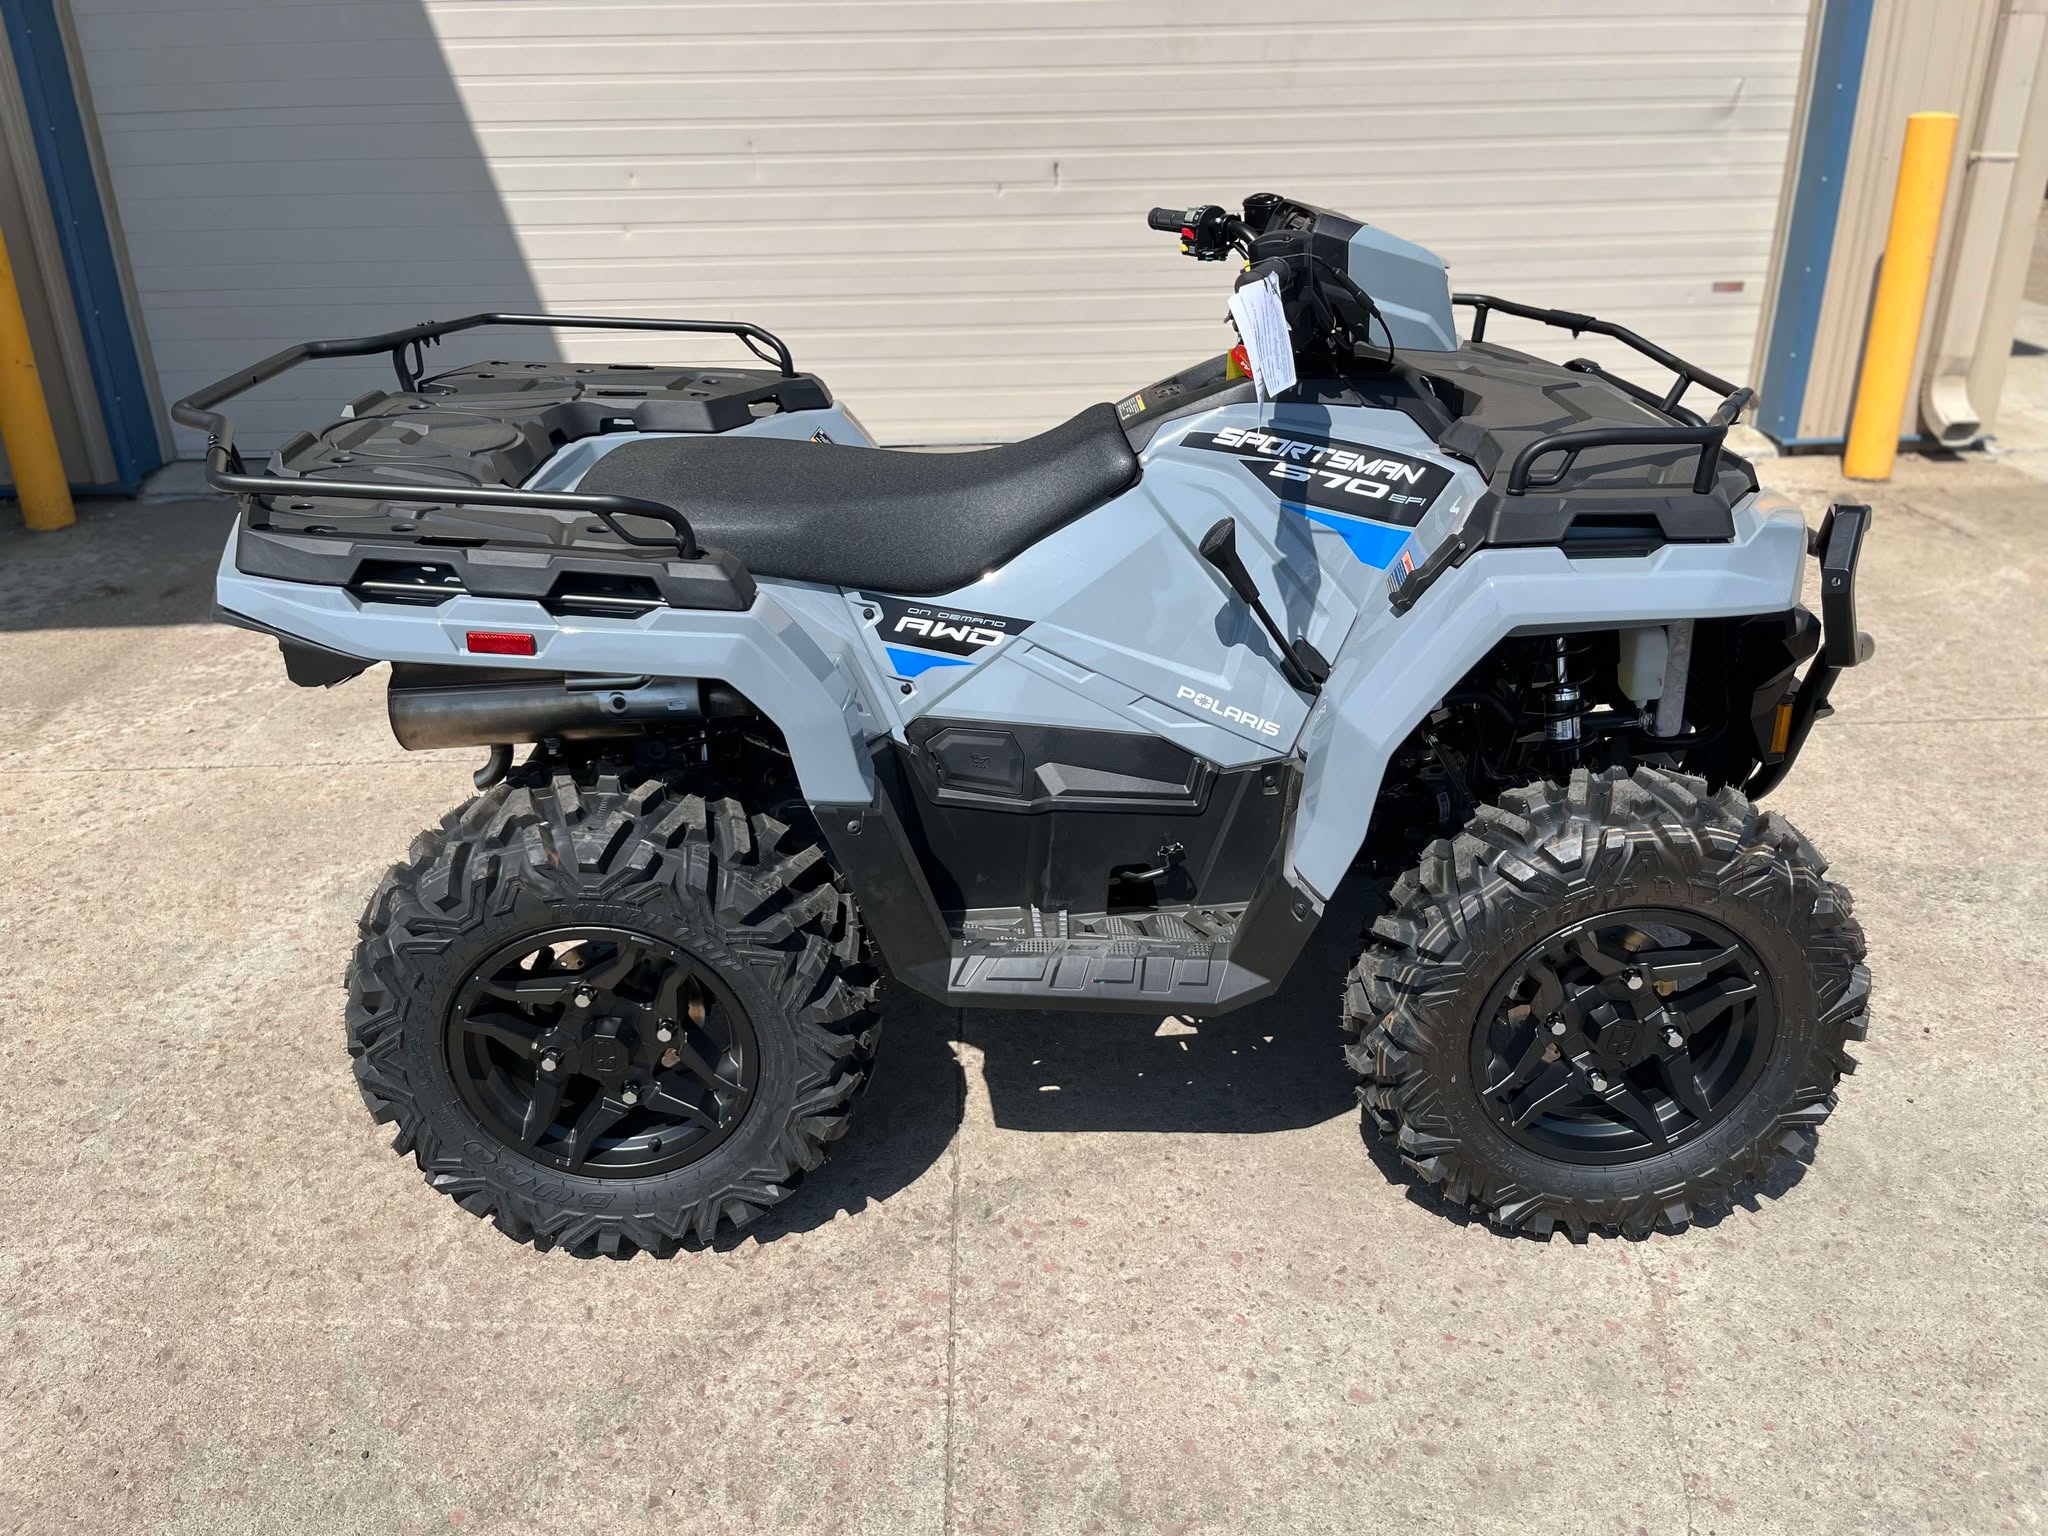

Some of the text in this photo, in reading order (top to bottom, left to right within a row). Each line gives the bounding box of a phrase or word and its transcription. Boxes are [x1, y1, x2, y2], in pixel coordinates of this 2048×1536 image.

[1212, 426, 1427, 485] SPORTSMAN
[1268, 461, 1427, 507] 570 EFI
[893, 616, 1006, 646] AWD
[907, 607, 1006, 628] ON DEMAND
[1176, 685, 1281, 737] POLARIS
